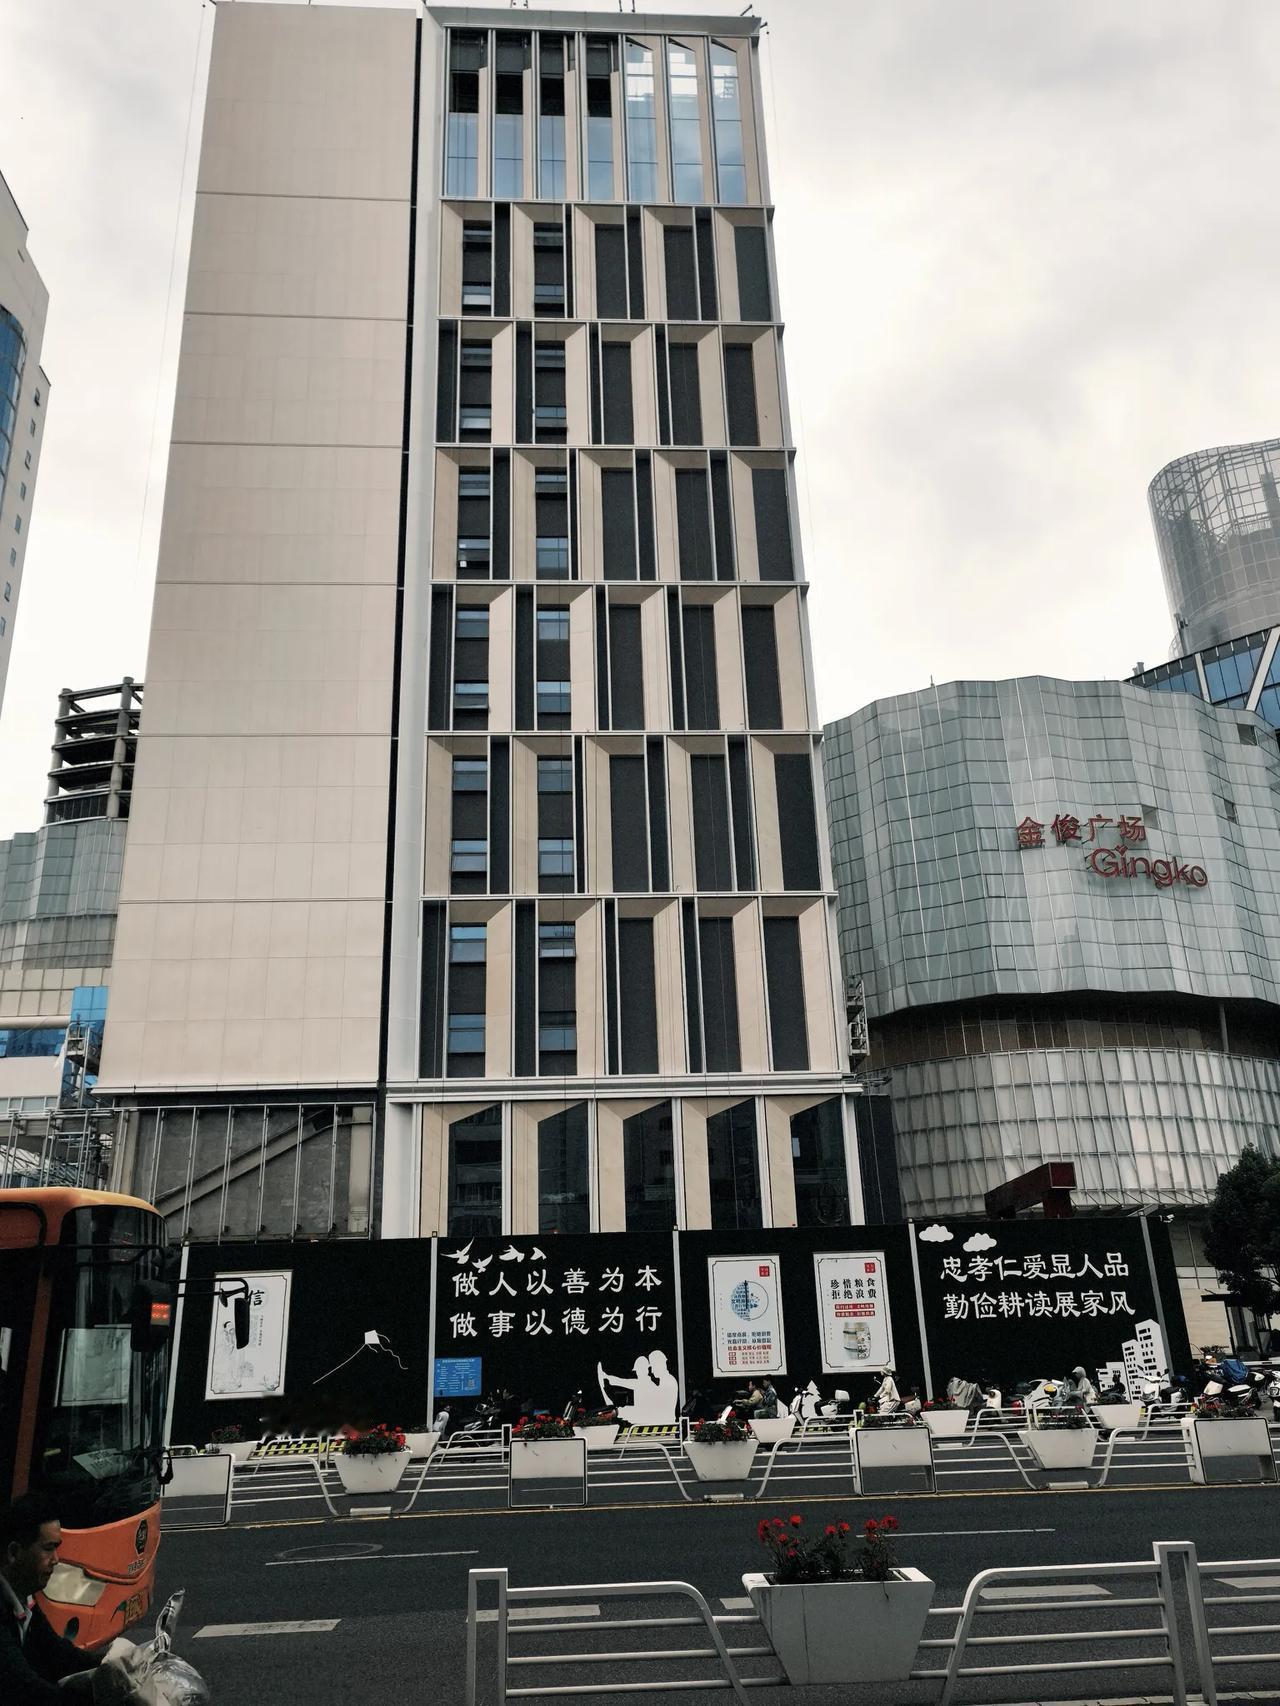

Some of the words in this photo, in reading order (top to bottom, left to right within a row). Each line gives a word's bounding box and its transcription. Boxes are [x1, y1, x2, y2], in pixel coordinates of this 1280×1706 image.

[1016, 813, 1147, 847] 金俊广场
[1090, 845, 1208, 889] Gingko
[451, 1264, 663, 1298] 做人以善为本
[830, 1277, 876, 1290] 珍惜粮食
[940, 1251, 1130, 1283] 忠孝仁爱显人品
[831, 1288, 877, 1300] 拒绝浪费
[943, 1289, 1136, 1320] 勤俭耕读展家风
[449, 1305, 663, 1339] 做事以德为行
